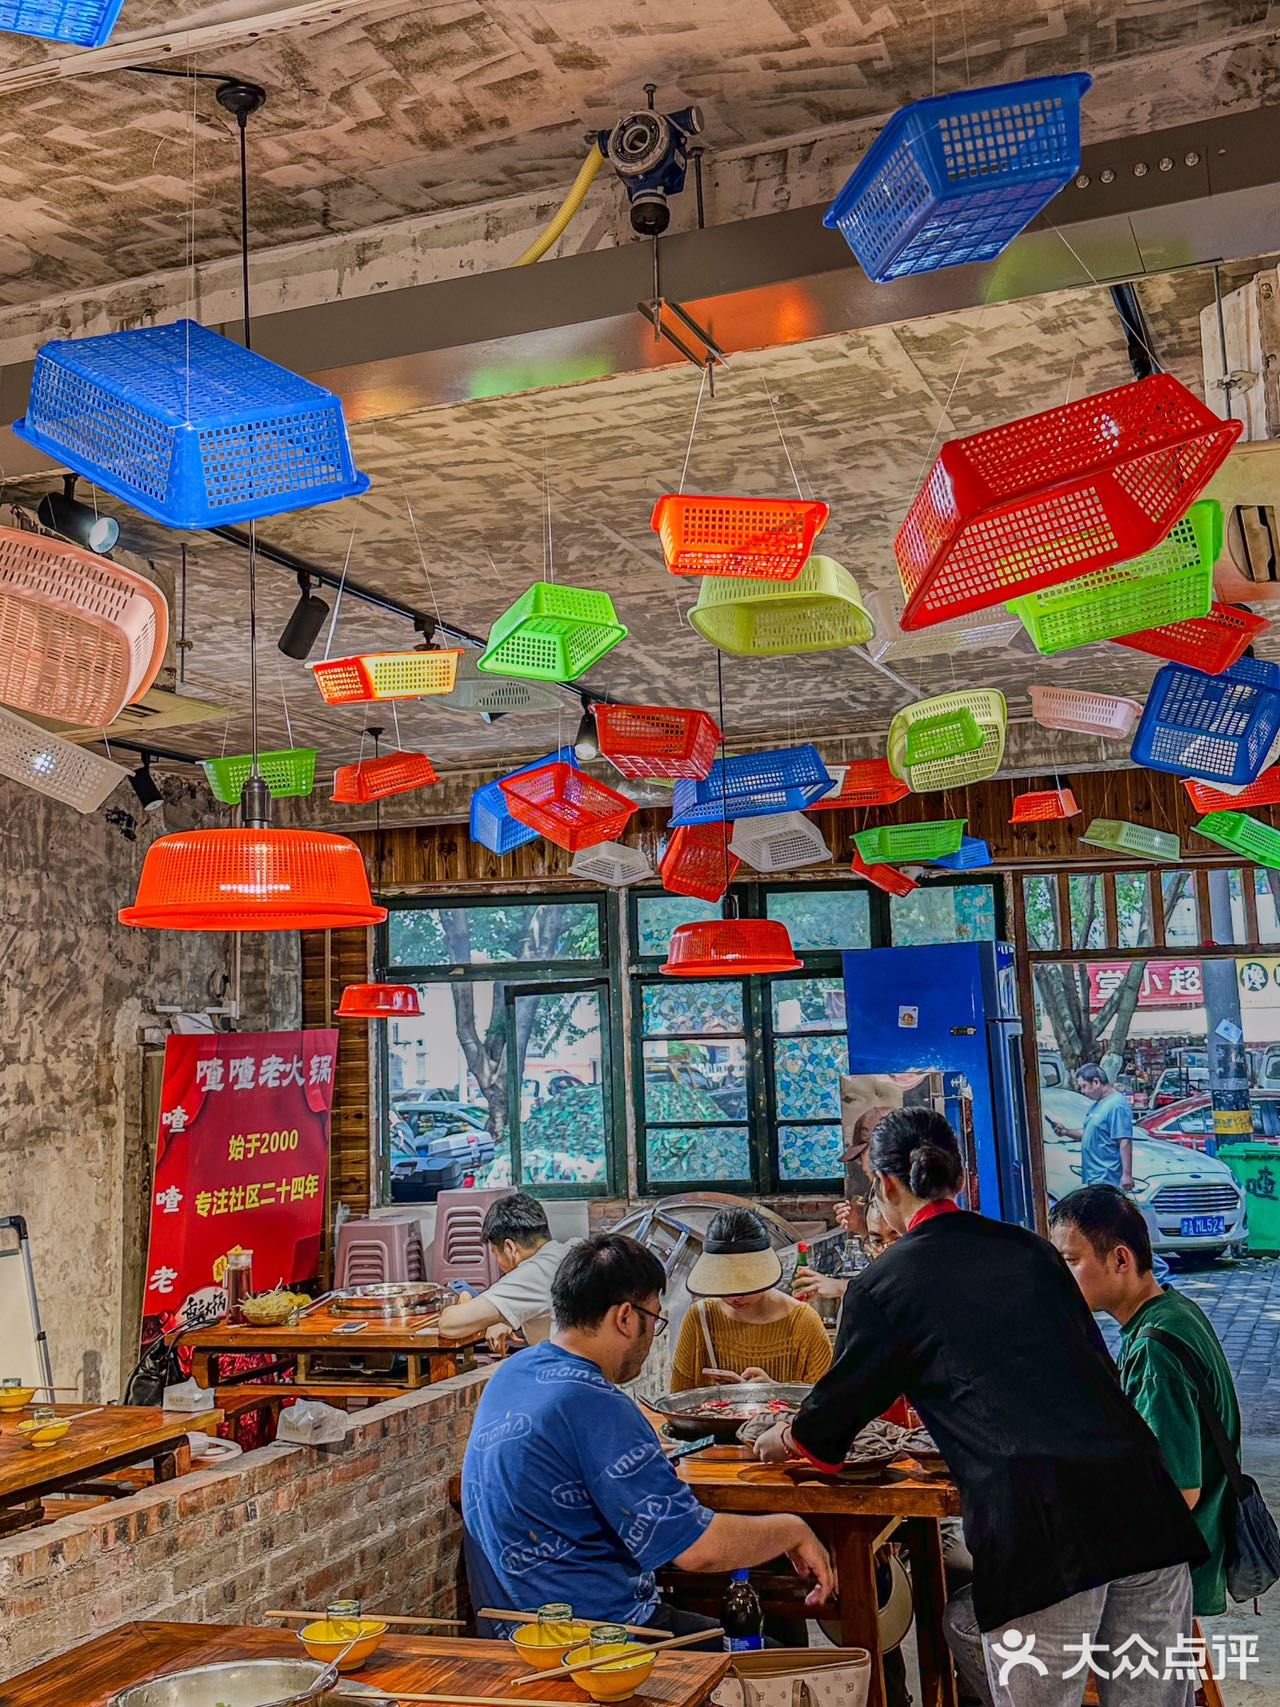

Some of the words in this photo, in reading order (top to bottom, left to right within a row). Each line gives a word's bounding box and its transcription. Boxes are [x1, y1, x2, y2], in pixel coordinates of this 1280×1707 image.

[228, 1129, 299, 1161] 始于2000
[195, 1173, 319, 1218] 专注社区二十四年
